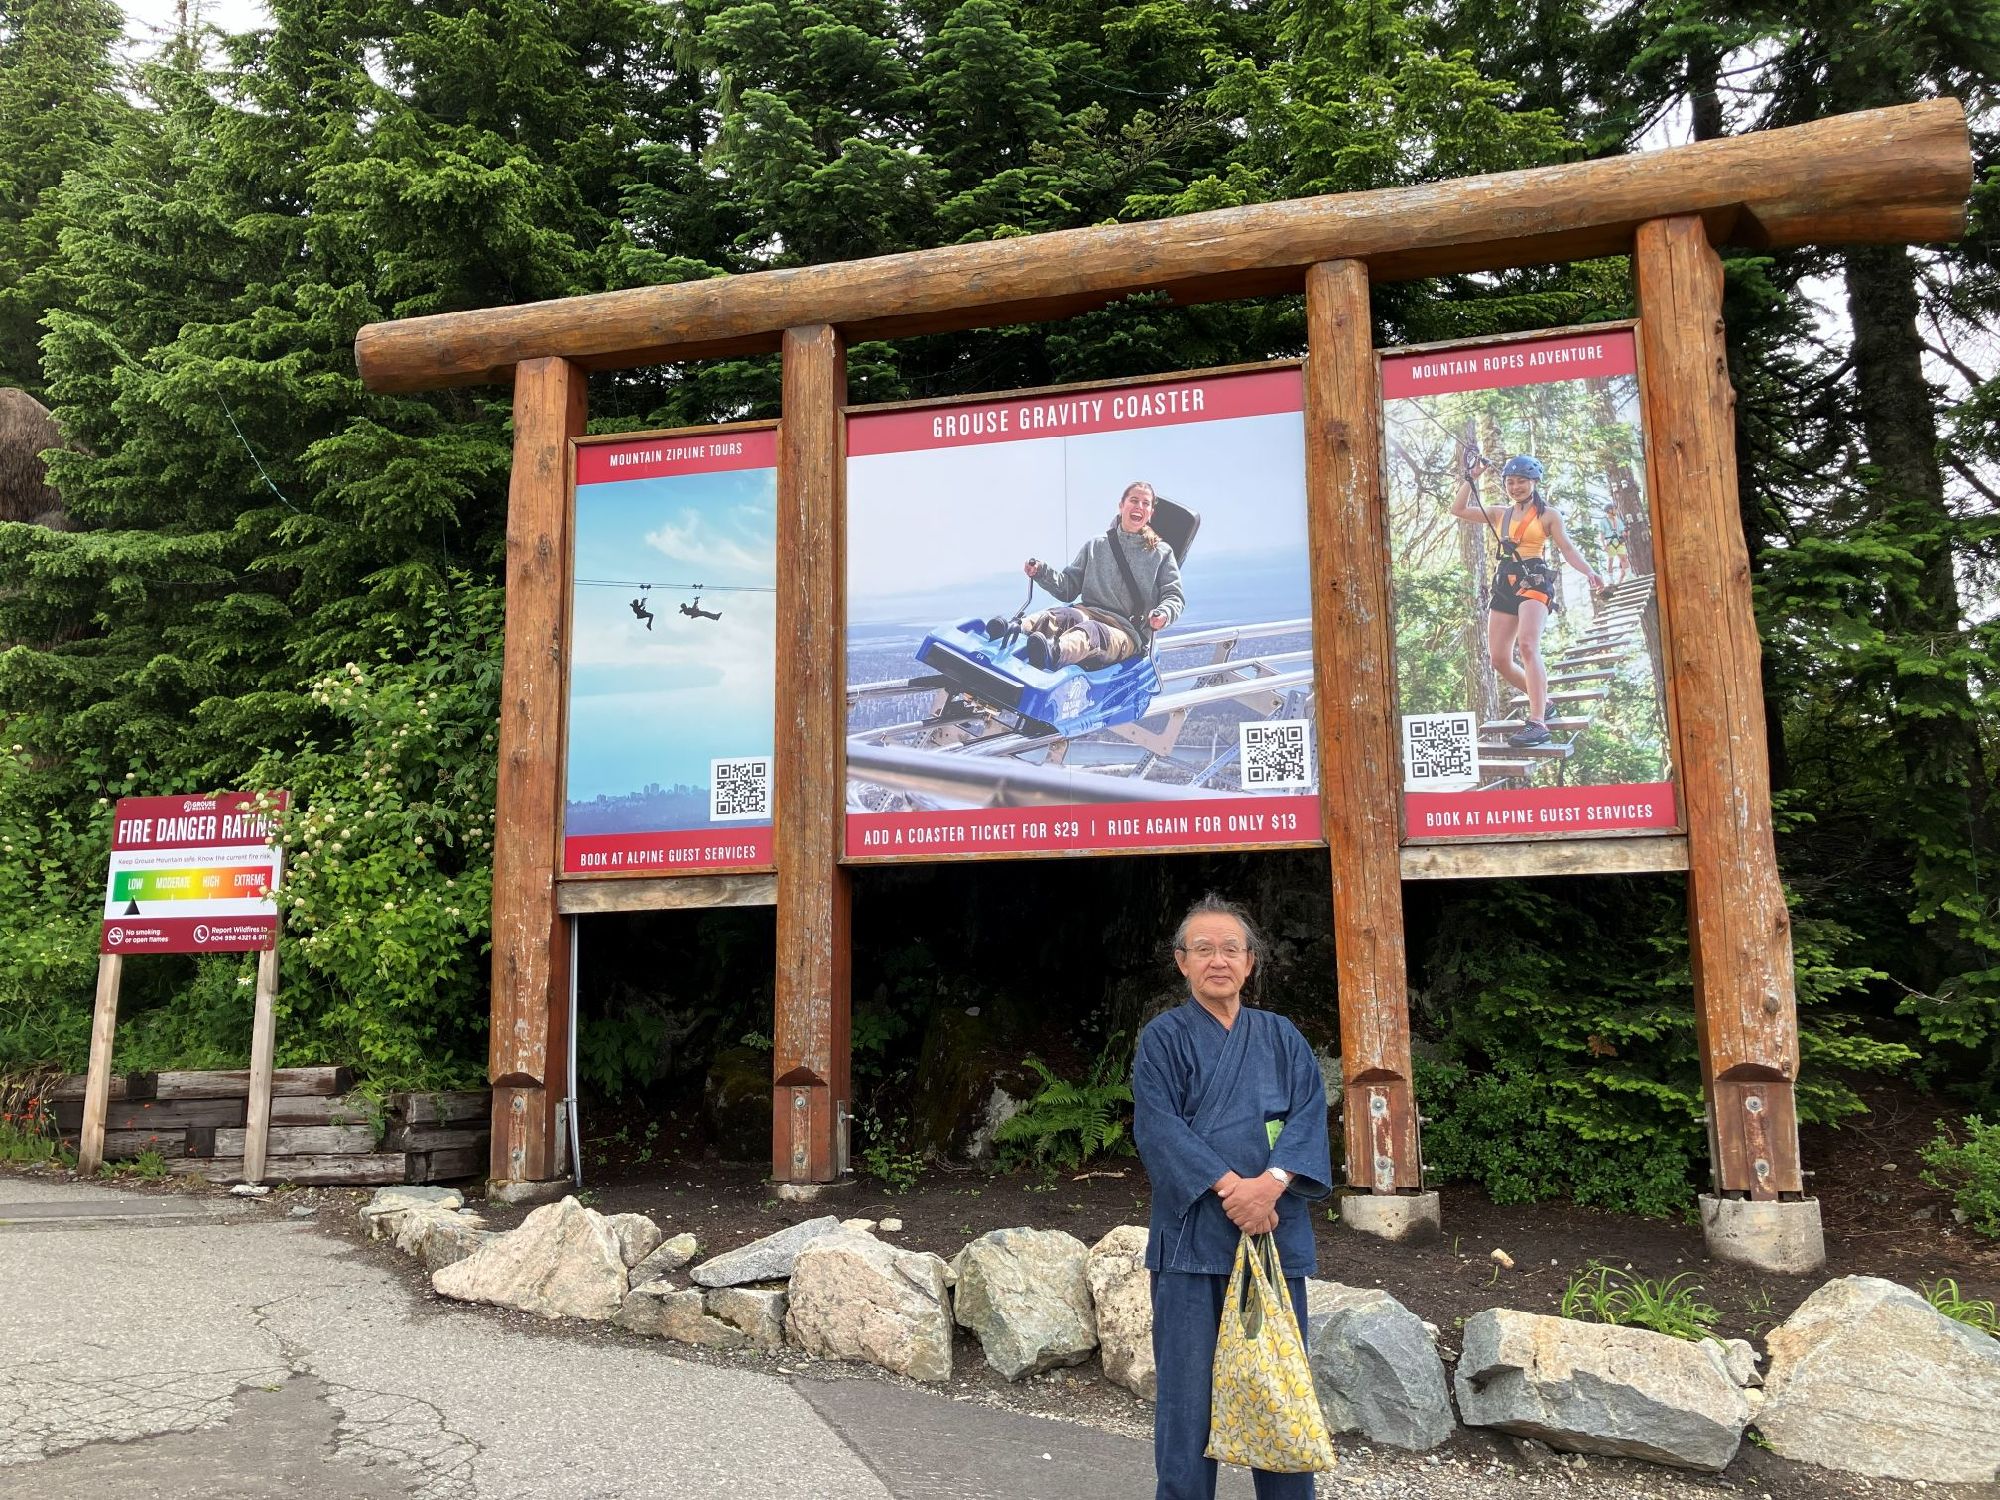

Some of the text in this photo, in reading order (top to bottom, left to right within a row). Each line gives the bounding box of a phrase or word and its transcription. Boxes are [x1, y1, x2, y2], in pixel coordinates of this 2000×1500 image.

[1412, 345, 1603, 380] MOUNTAIN ROPES ADVENTURE
[933, 388, 1204, 438] GROUSE GRAVITY COASTER
[609, 442, 743, 467] MOUNTAIN ZIPLINE TOURS
[192, 800, 216, 808] GROUSE
[1426, 803, 1653, 827] BOOK AT ALPINE GUEST SERVICES
[117, 818, 153, 844] FIRE
[156, 815, 217, 842] DANGER
[864, 821, 1079, 845] ADD A COASTER TICKET FOR $29
[1108, 813, 1297, 836] RIDE AGAIN FOR ONLY $13
[118, 858, 133, 866] Keep
[156, 856, 182, 864] Mountain
[580, 845, 756, 866] BOOK AT ALPINE GUEST SERVICES
[127, 877, 144, 890] LOW
[155, 876, 192, 889] MODERATE
[202, 875, 220, 888] HIGH
[234, 873, 266, 887] EXTREME
[135, 928, 161, 936] smoking
[211, 926, 232, 934] Report
[234, 925, 260, 933] Wildfires
